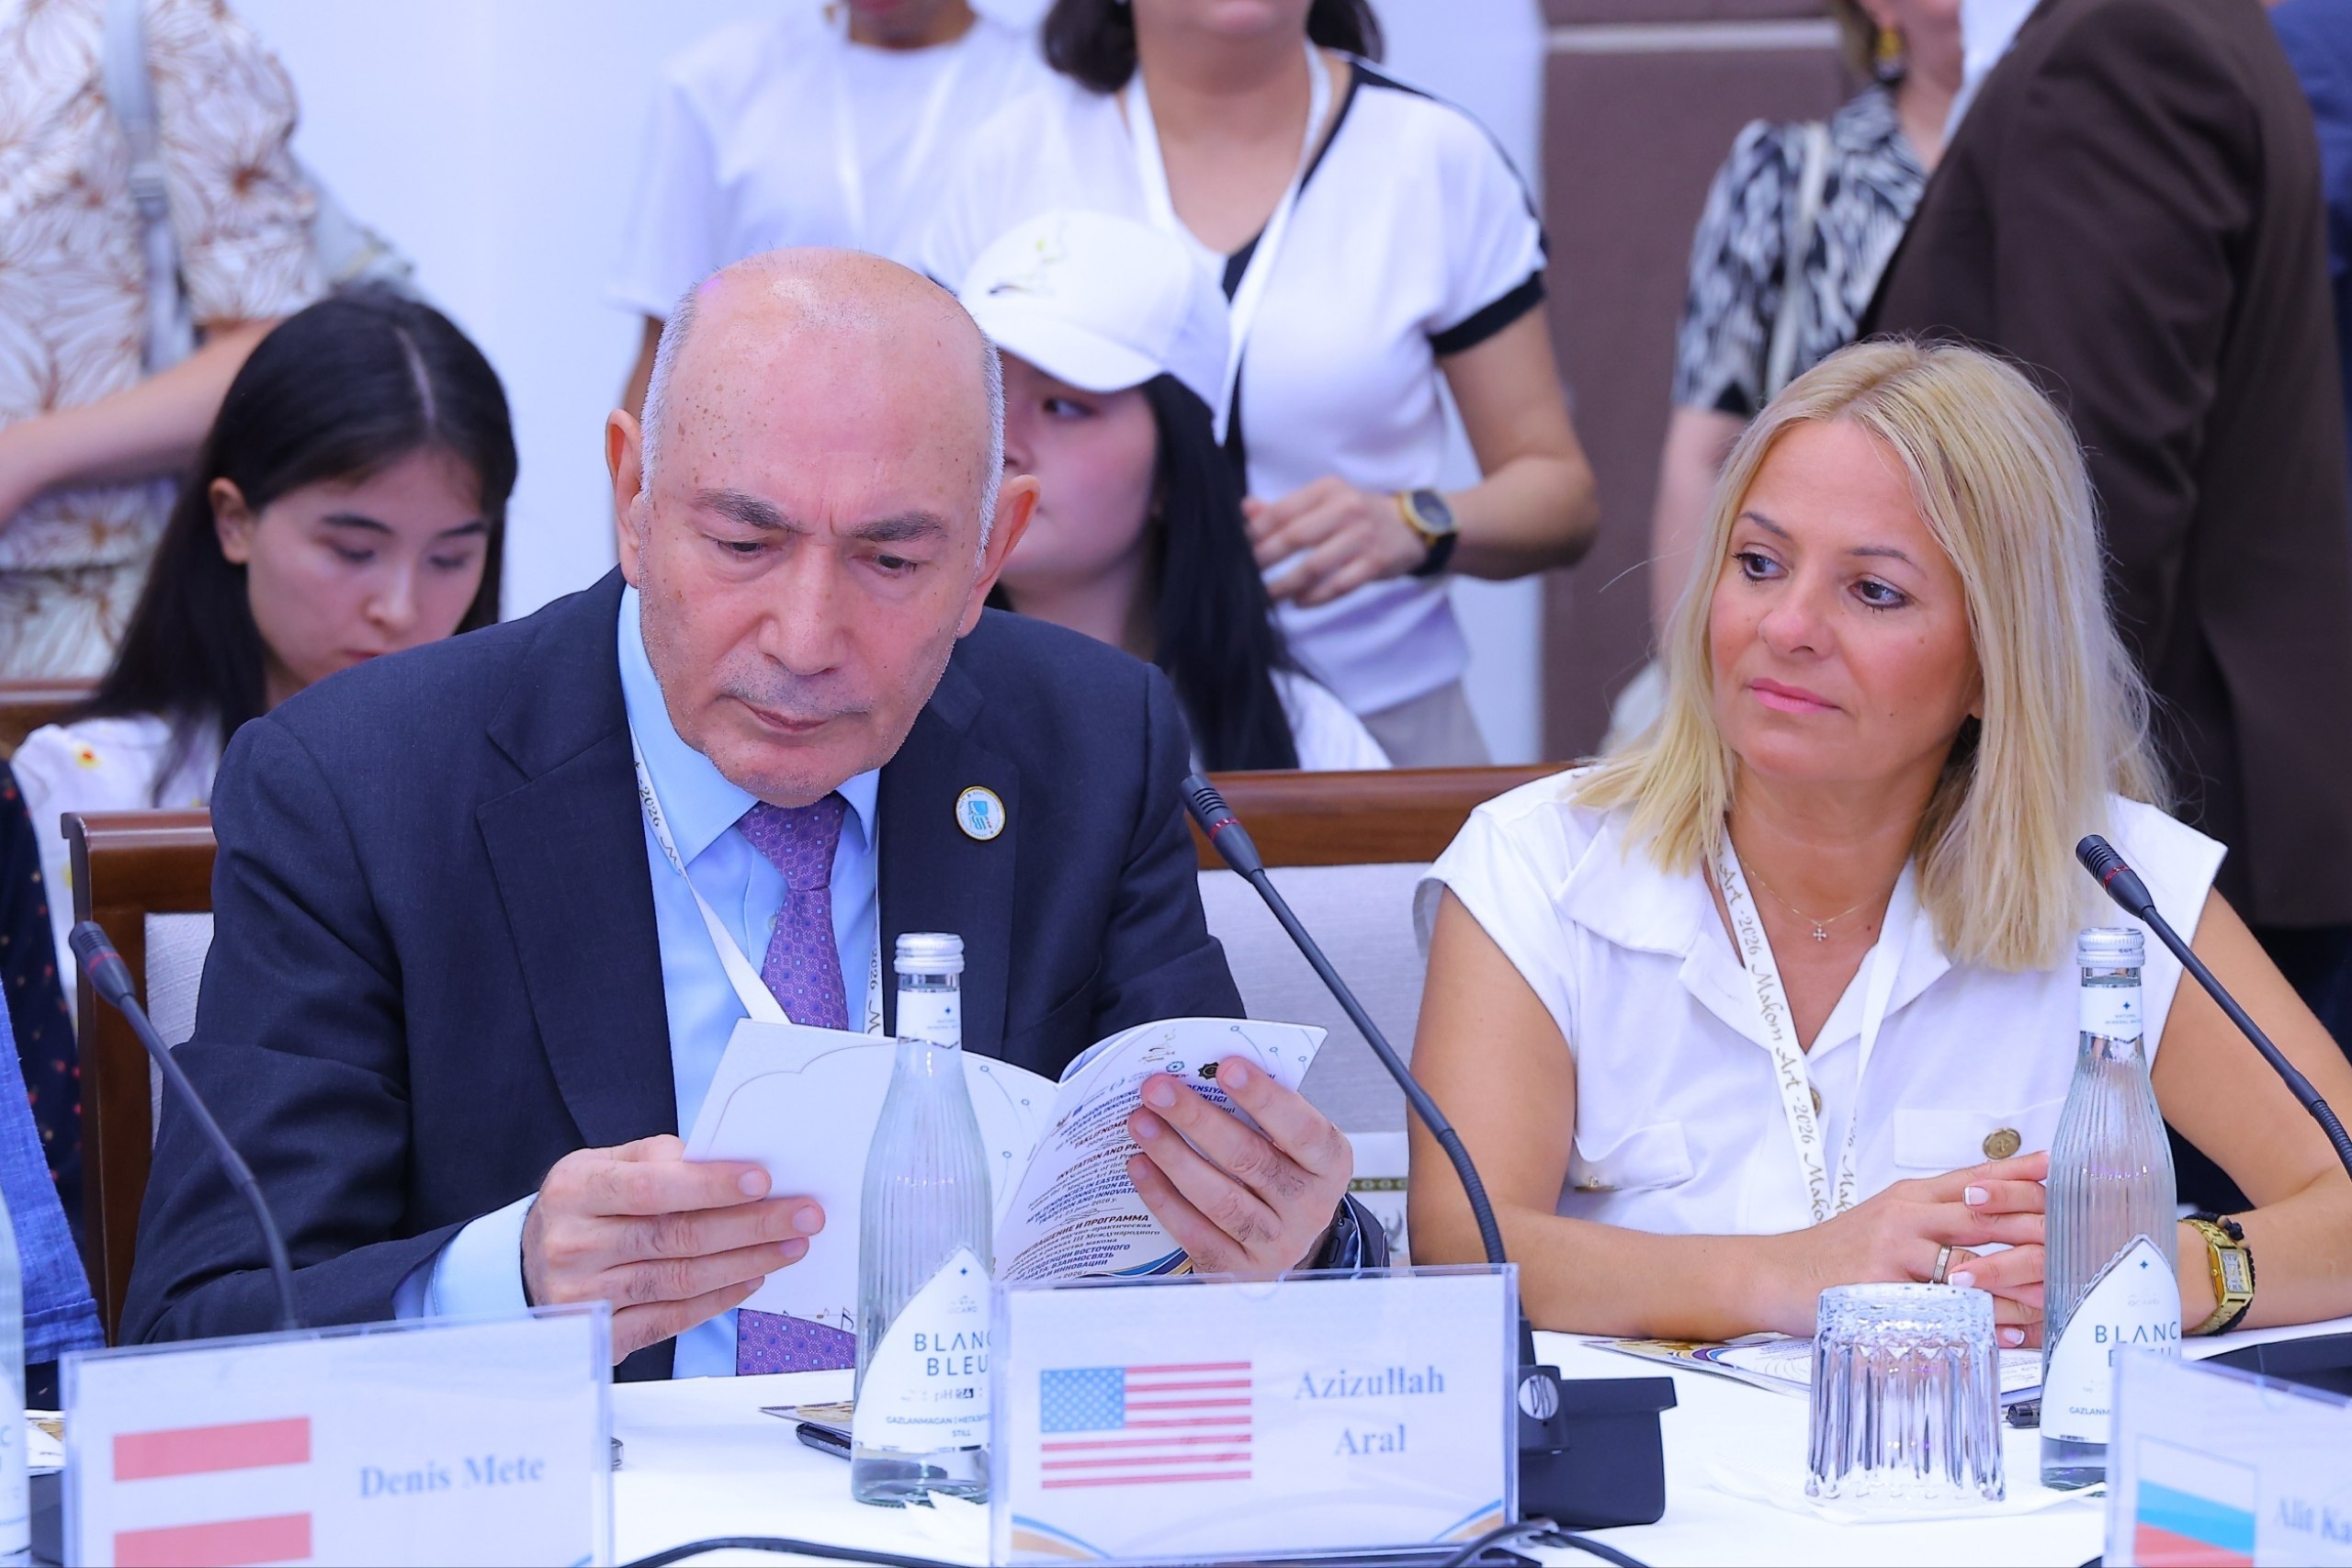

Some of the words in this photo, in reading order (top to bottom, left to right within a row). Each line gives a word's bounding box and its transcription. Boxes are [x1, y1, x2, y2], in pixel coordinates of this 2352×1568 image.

[1751, 963, 1784, 1043] Makom
[1775, 1047, 1803, 1091] Art
[1804, 1152, 1831, 1222] Mako
[1057, 1152, 1103, 1181] INVITATION
[1102, 1145, 1125, 1157] AND
[1834, 1154, 1856, 1215] Mak
[1084, 1214, 1149, 1228] ПРОГРАММА
[1085, 1230, 1161, 1240] Международного
[1051, 1252, 1114, 1269] ВЗАИМОСВЯЗЬ
[1074, 1244, 1132, 1257] ВОСТОЧНОГО
[1053, 1259, 1109, 1275] ИННОВАЦИИ
[2095, 1321, 2177, 1343] BLANC
[927, 1354, 989, 1377] BLEU
[1294, 1365, 1446, 1400] Azizullah
[1334, 1423, 1408, 1456] Aral
[359, 1459, 451, 1499] Denis
[463, 1454, 546, 1487] Mete
